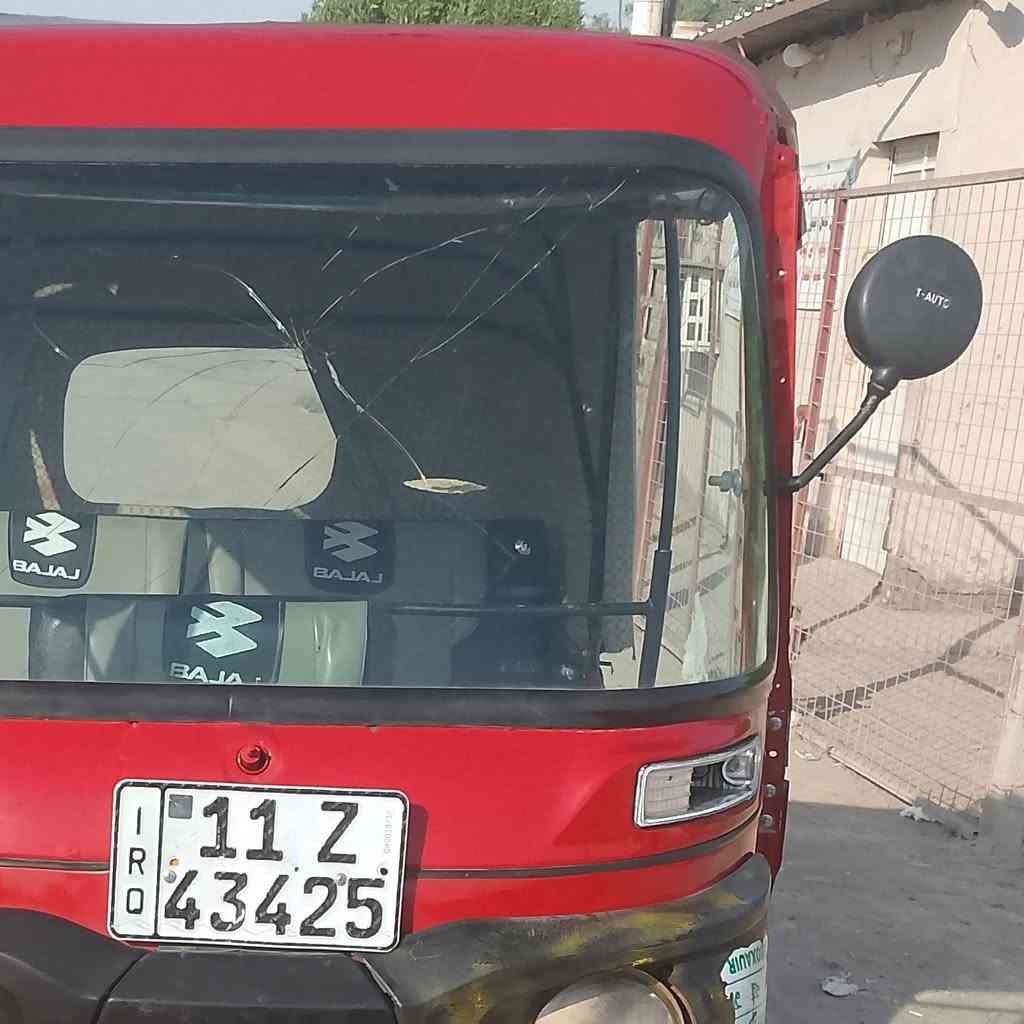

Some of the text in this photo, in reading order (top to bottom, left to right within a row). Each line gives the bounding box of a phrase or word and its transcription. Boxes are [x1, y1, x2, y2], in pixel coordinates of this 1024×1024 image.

[12, 559, 81, 580] BAJAJ
[313, 566, 384, 584] BAJAJ
[199, 796, 284, 861] 11
[317, 800, 360, 864] Z
[163, 869, 386, 939] 43425
